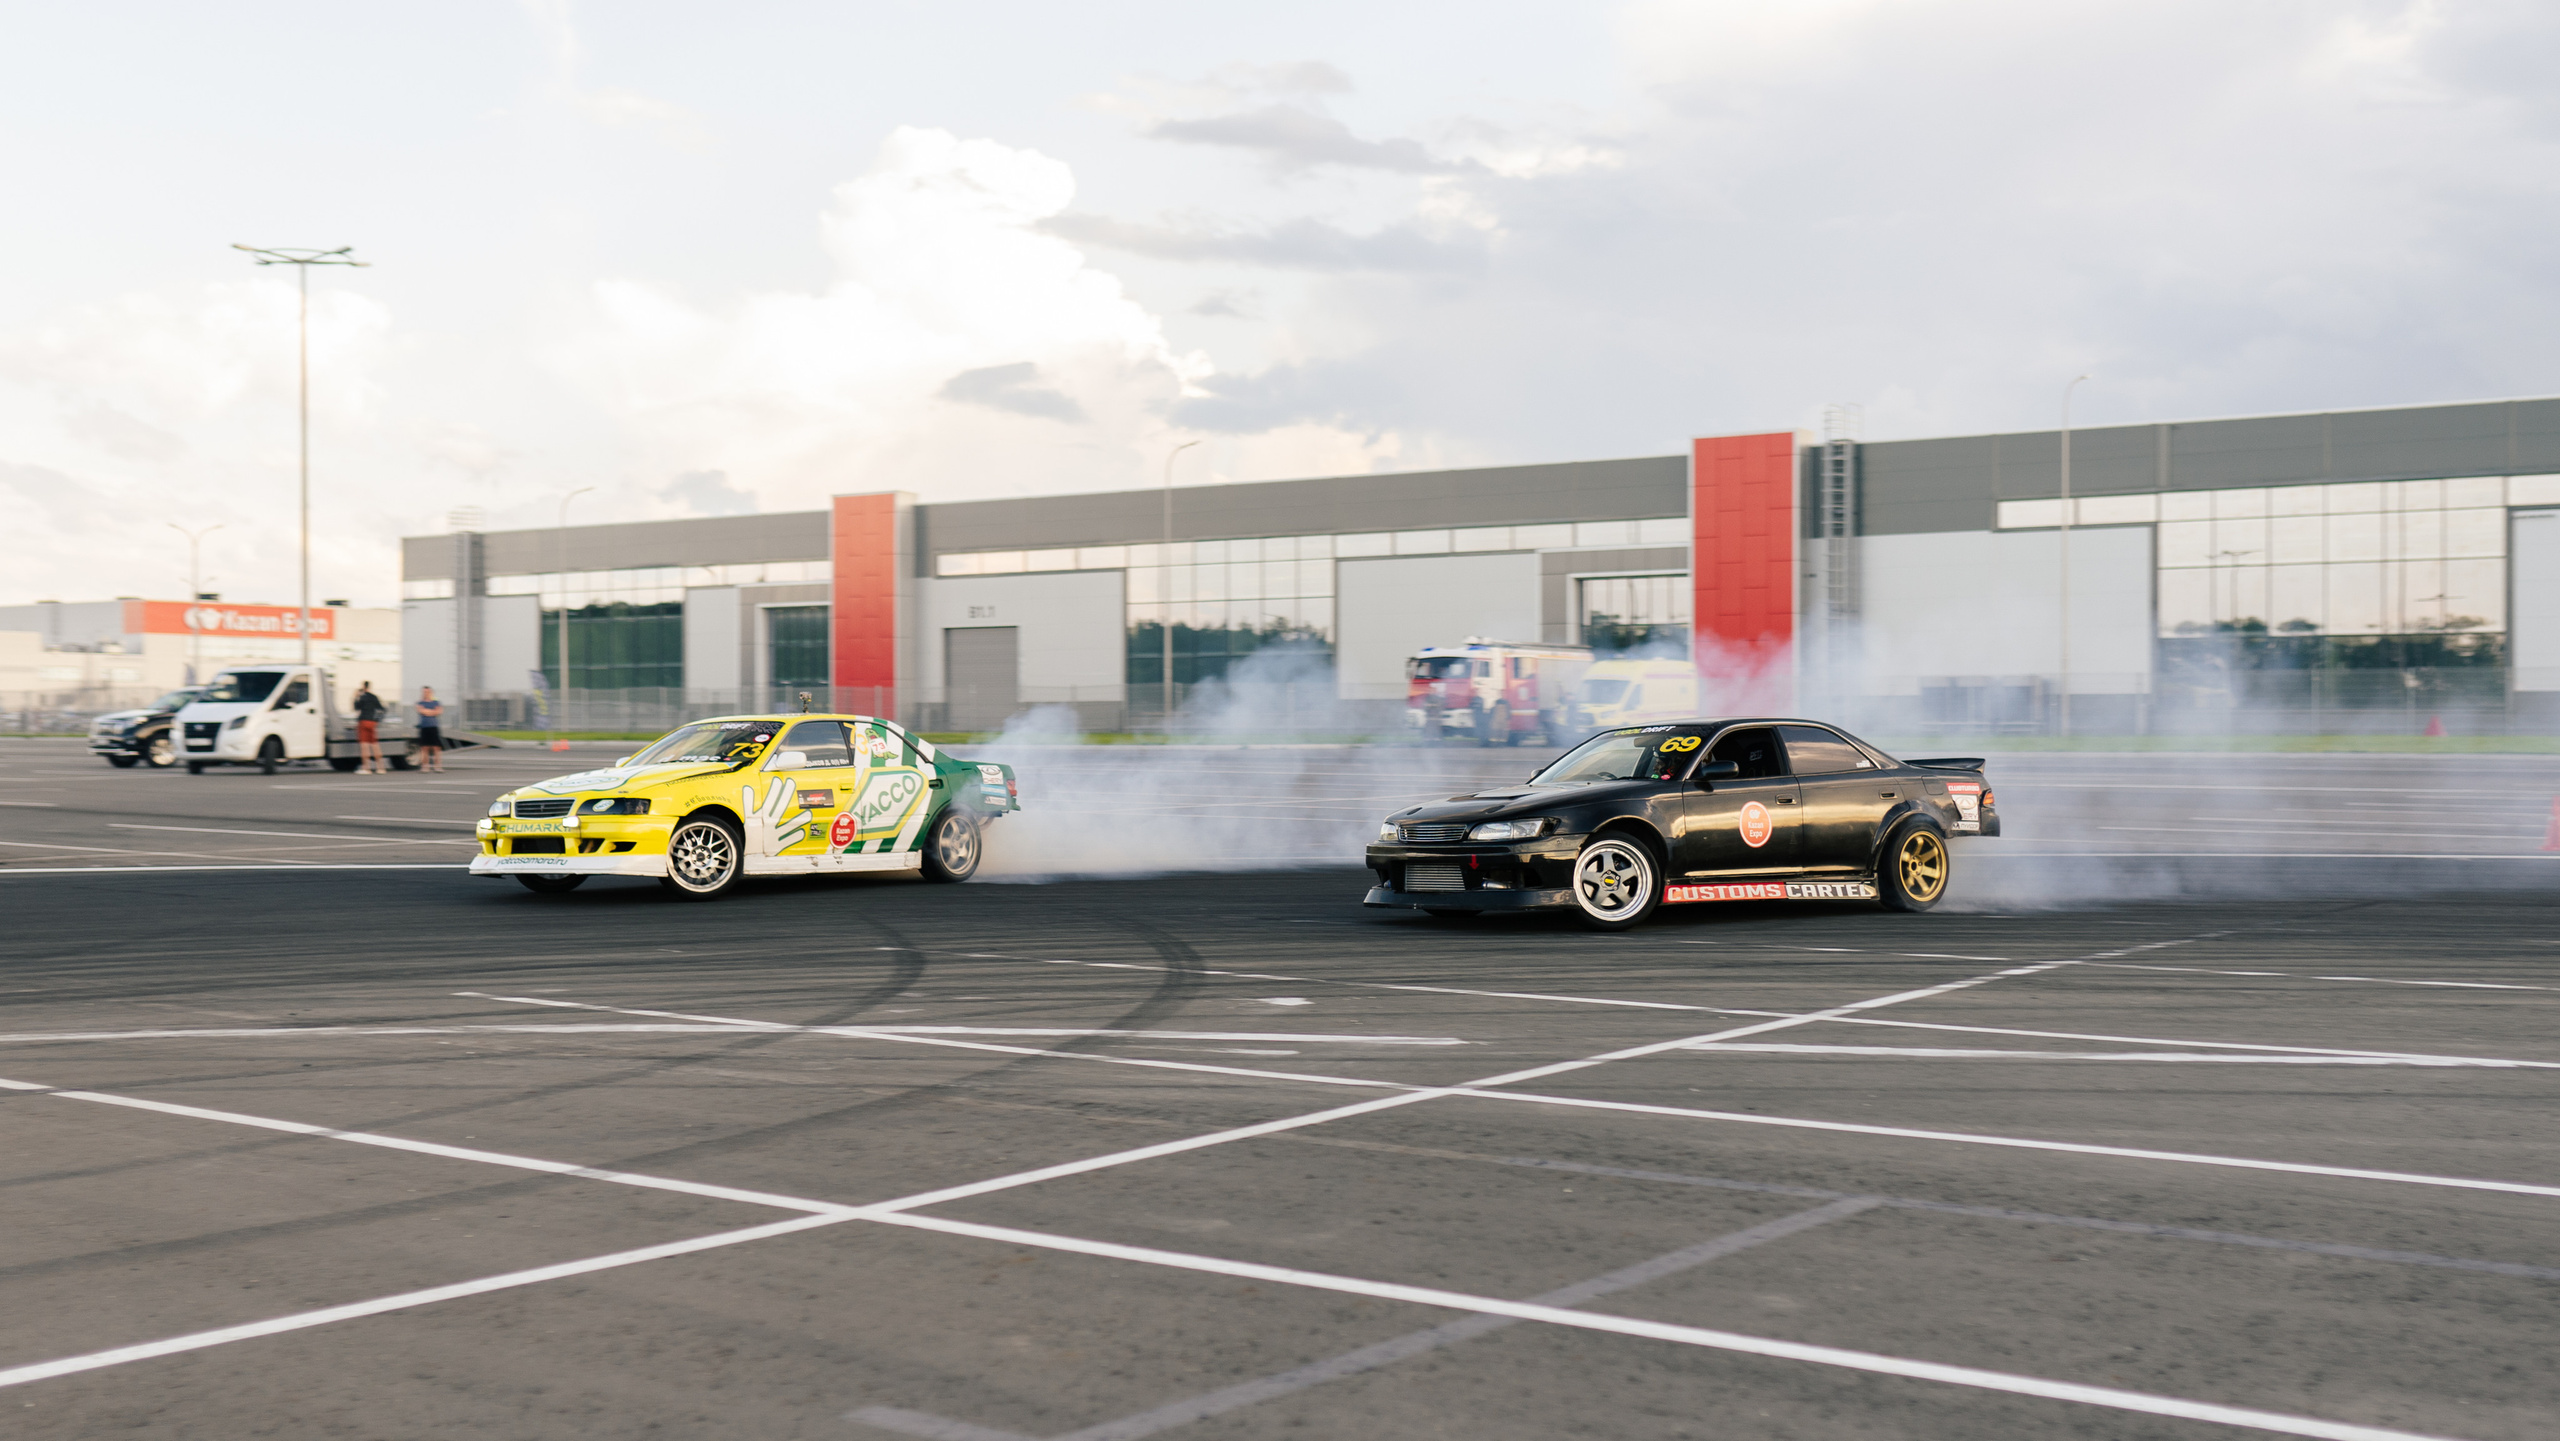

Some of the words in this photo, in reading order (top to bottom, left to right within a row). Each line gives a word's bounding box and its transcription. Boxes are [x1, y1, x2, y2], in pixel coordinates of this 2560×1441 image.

[222, 610, 281, 631] Kazan
[282, 612, 329, 633] Expo
[1640, 725, 1677, 734] DRIFT
[727, 742, 765, 758] 73
[872, 742, 886, 751] 73
[1659, 736, 1702, 753] 69
[853, 775, 916, 826] YACCO
[1747, 821, 1764, 829] Kazan
[1749, 830, 1763, 838] Expo
[1667, 884, 1781, 900] CUSTOMS
[1785, 883, 1872, 898] CARTEL
